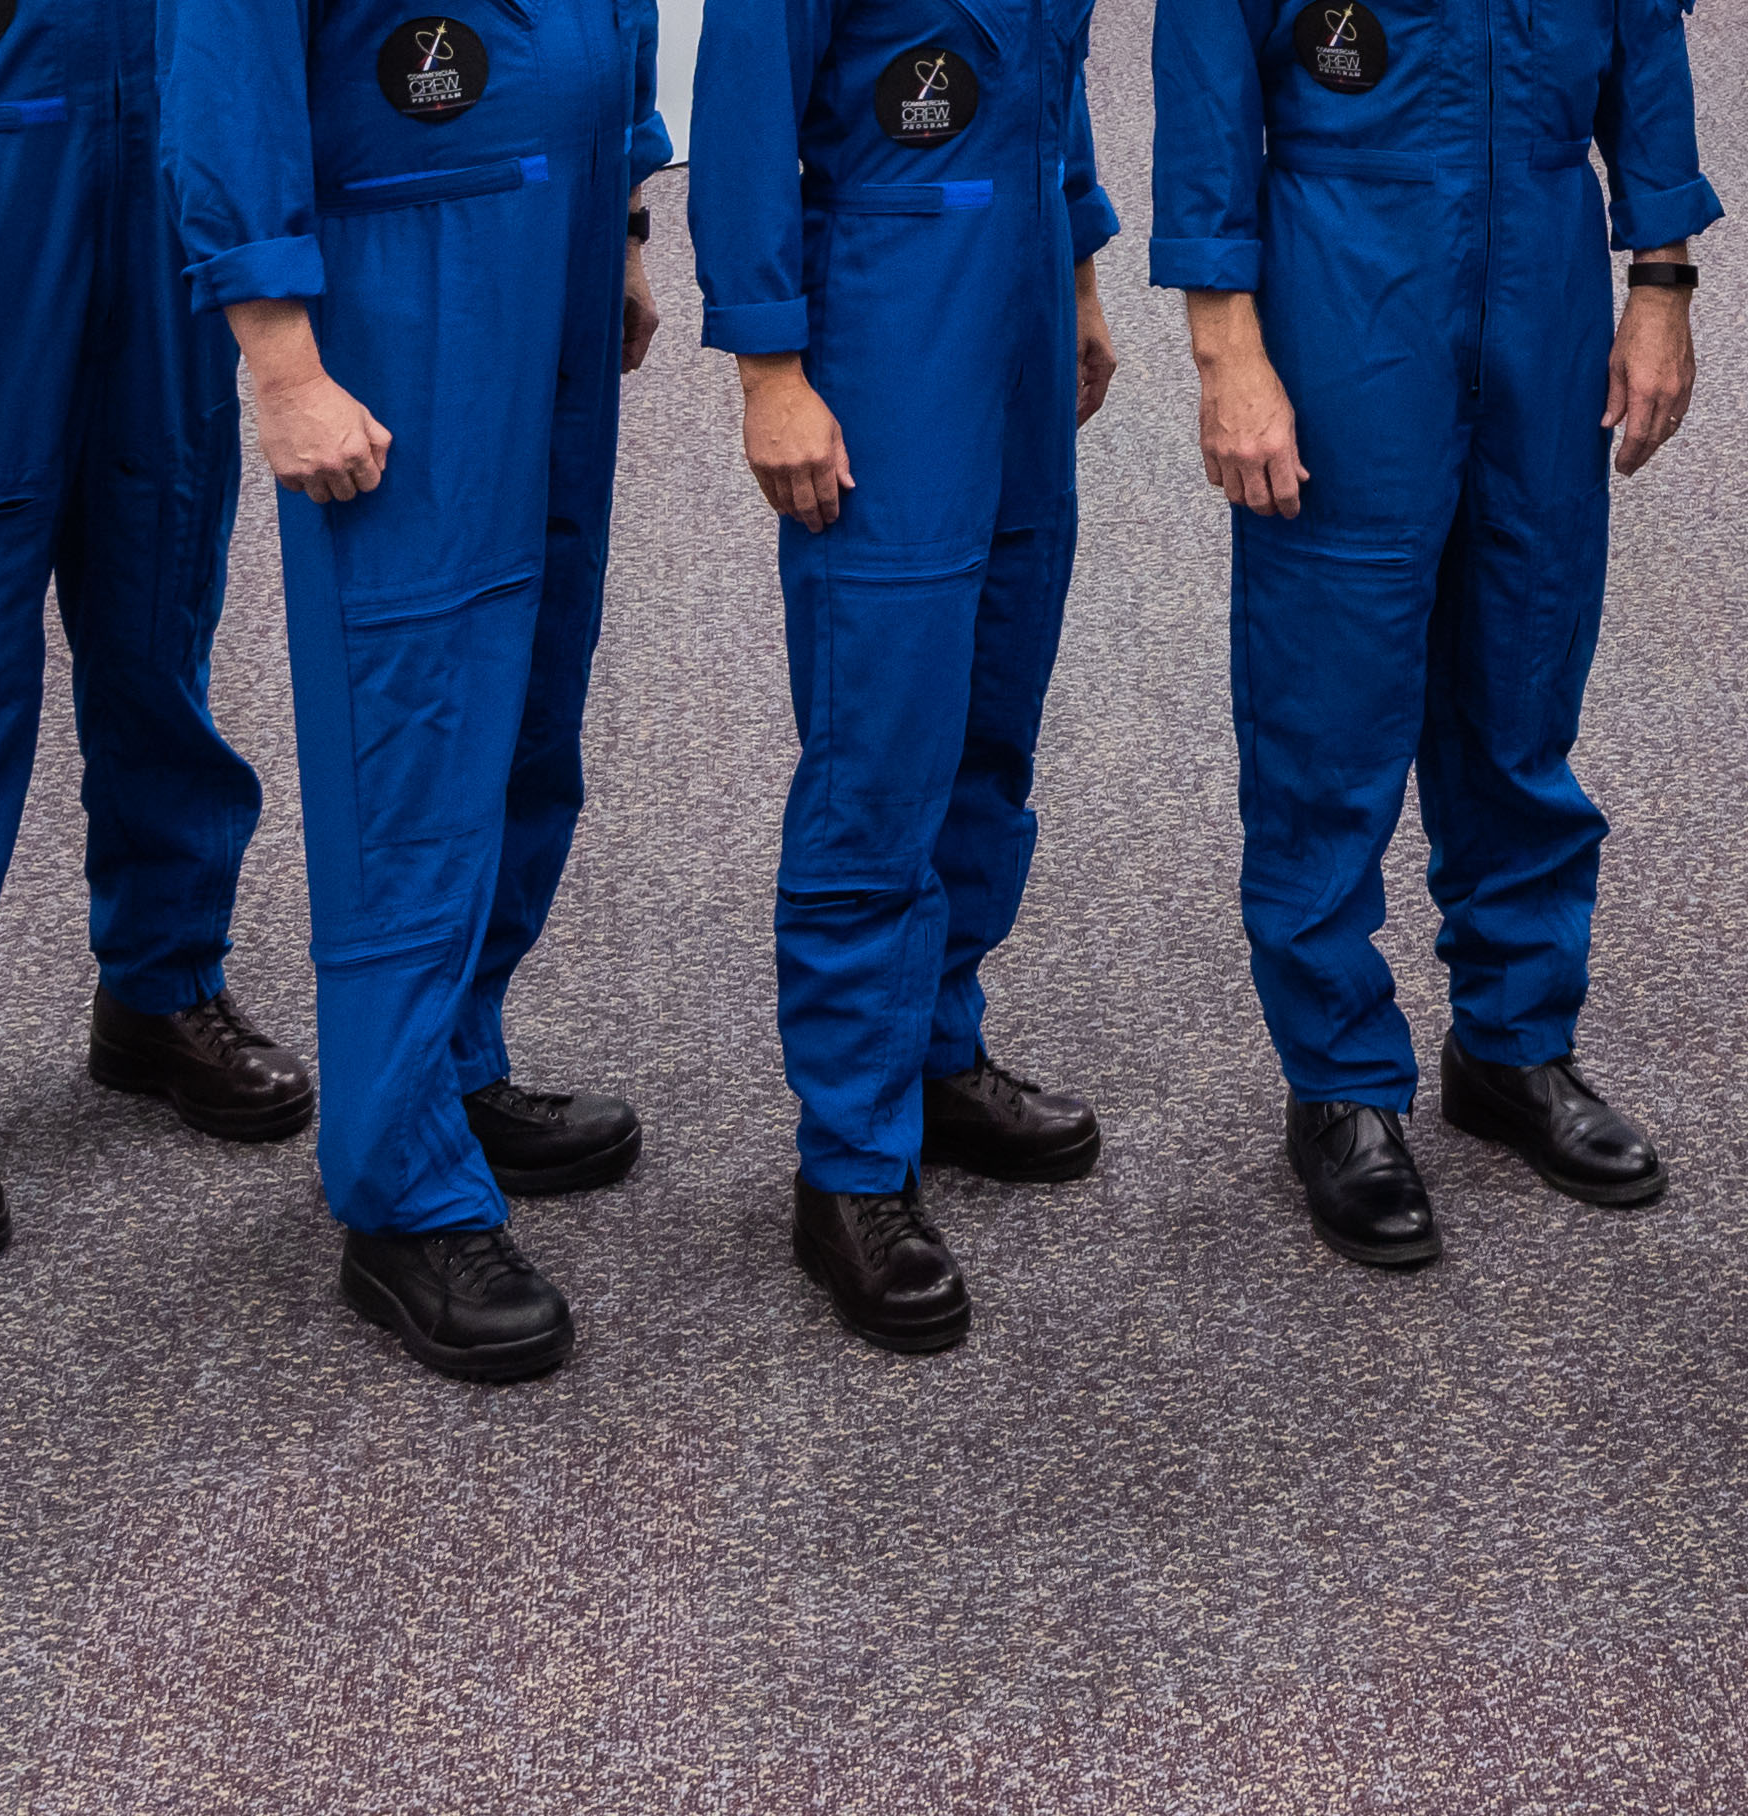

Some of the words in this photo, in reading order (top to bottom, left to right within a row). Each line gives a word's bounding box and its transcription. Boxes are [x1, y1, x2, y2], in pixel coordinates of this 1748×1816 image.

[1317, 53, 1360, 70] CREW
[409, 75, 460, 94] CREW
[902, 106, 951, 122] CREW
